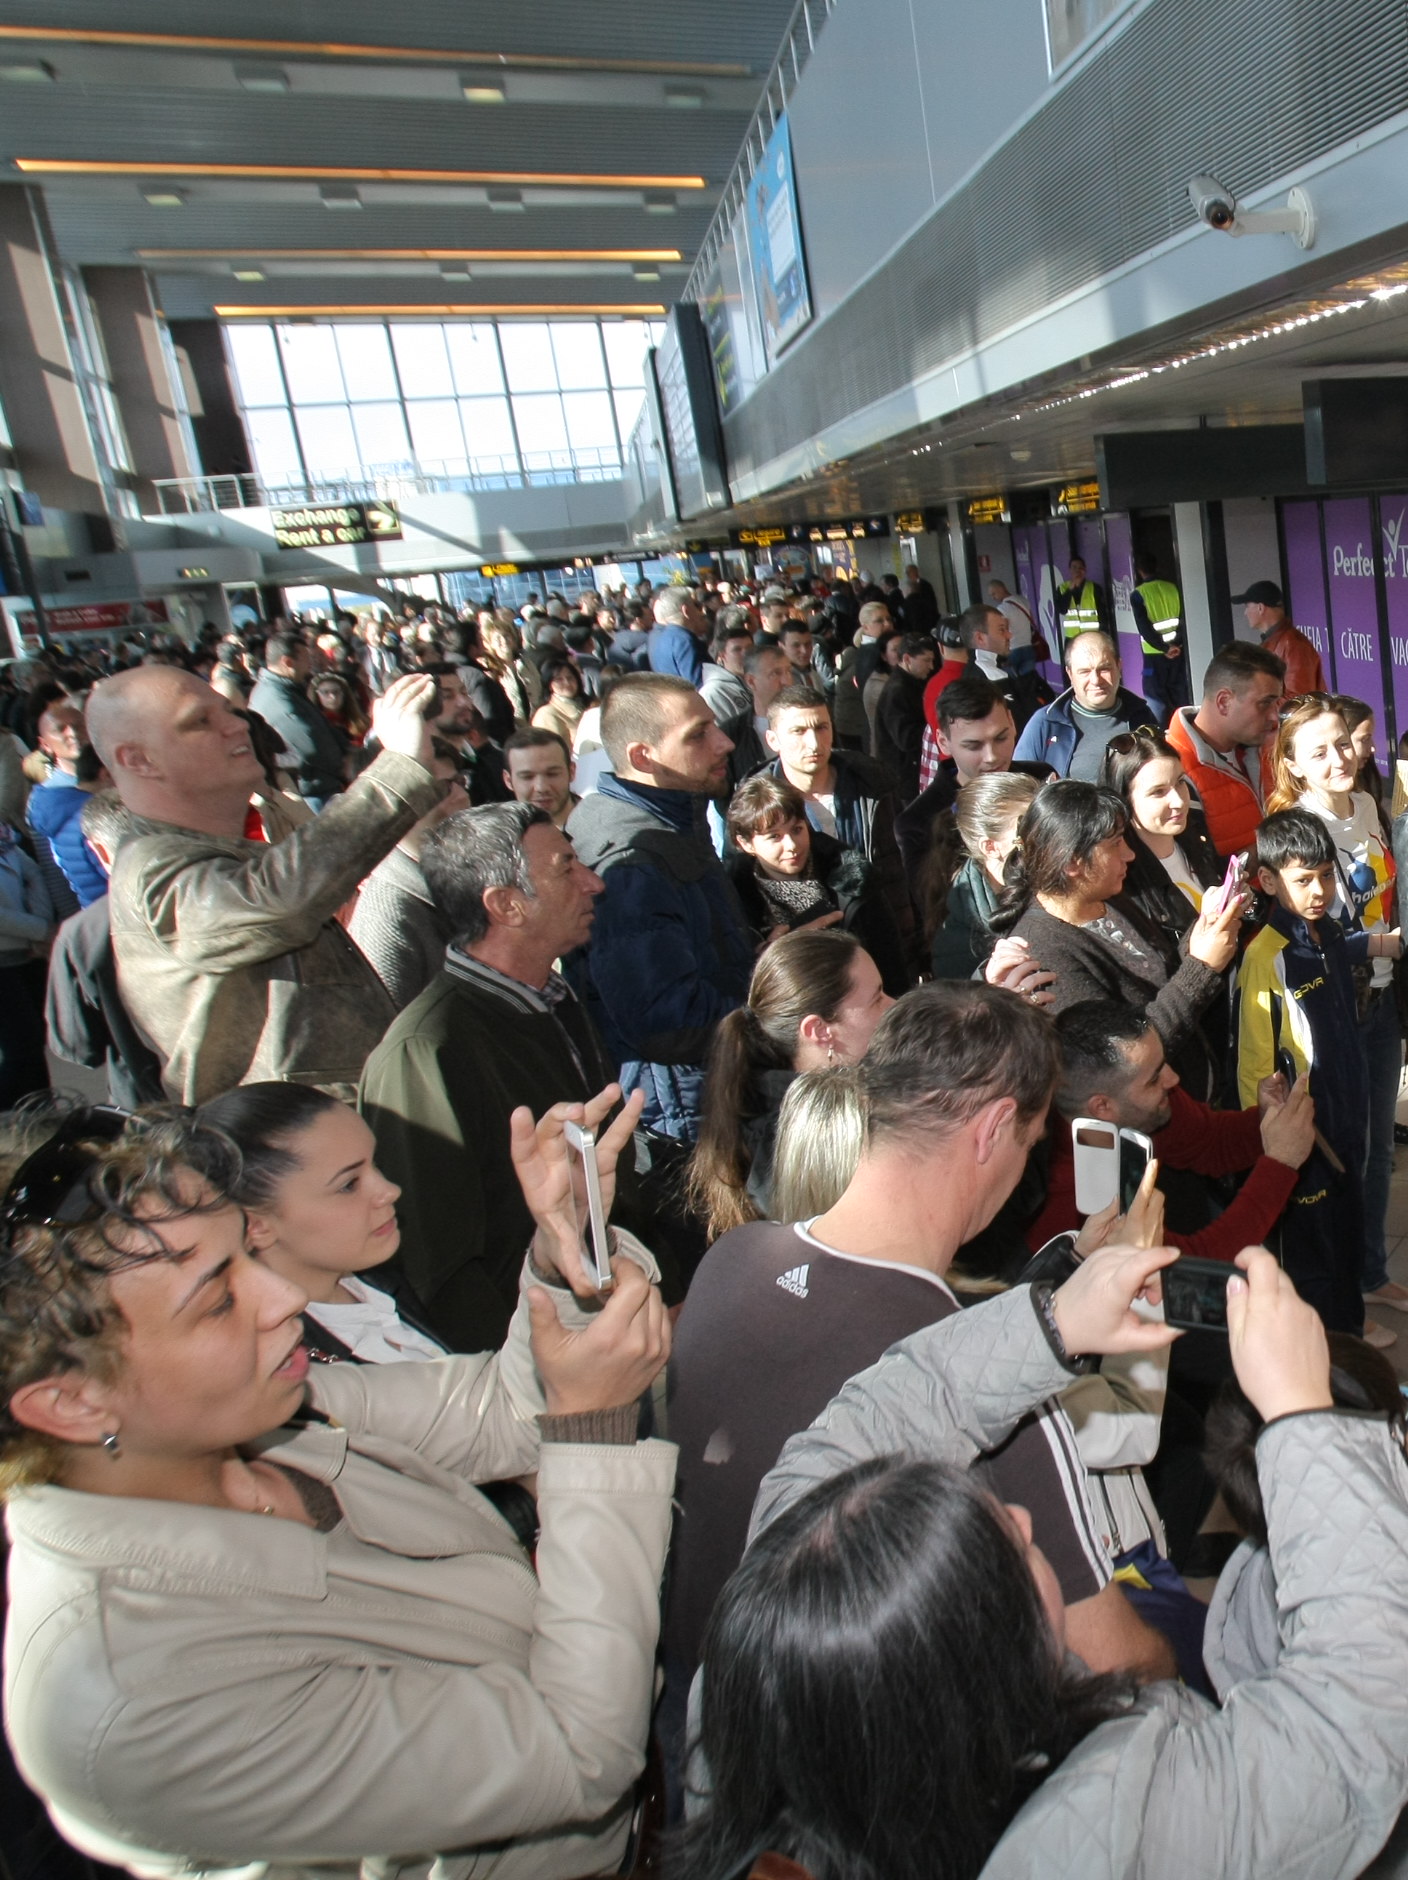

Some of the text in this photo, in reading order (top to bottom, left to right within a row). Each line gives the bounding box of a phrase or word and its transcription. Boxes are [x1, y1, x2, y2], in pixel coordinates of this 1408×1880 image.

[271, 507, 361, 528] Exchange
[275, 526, 366, 546] Rent a car
[1333, 542, 1396, 578] Perfect
[1340, 627, 1374, 662] CĂTRE
[776, 1275, 809, 1299] adidas
